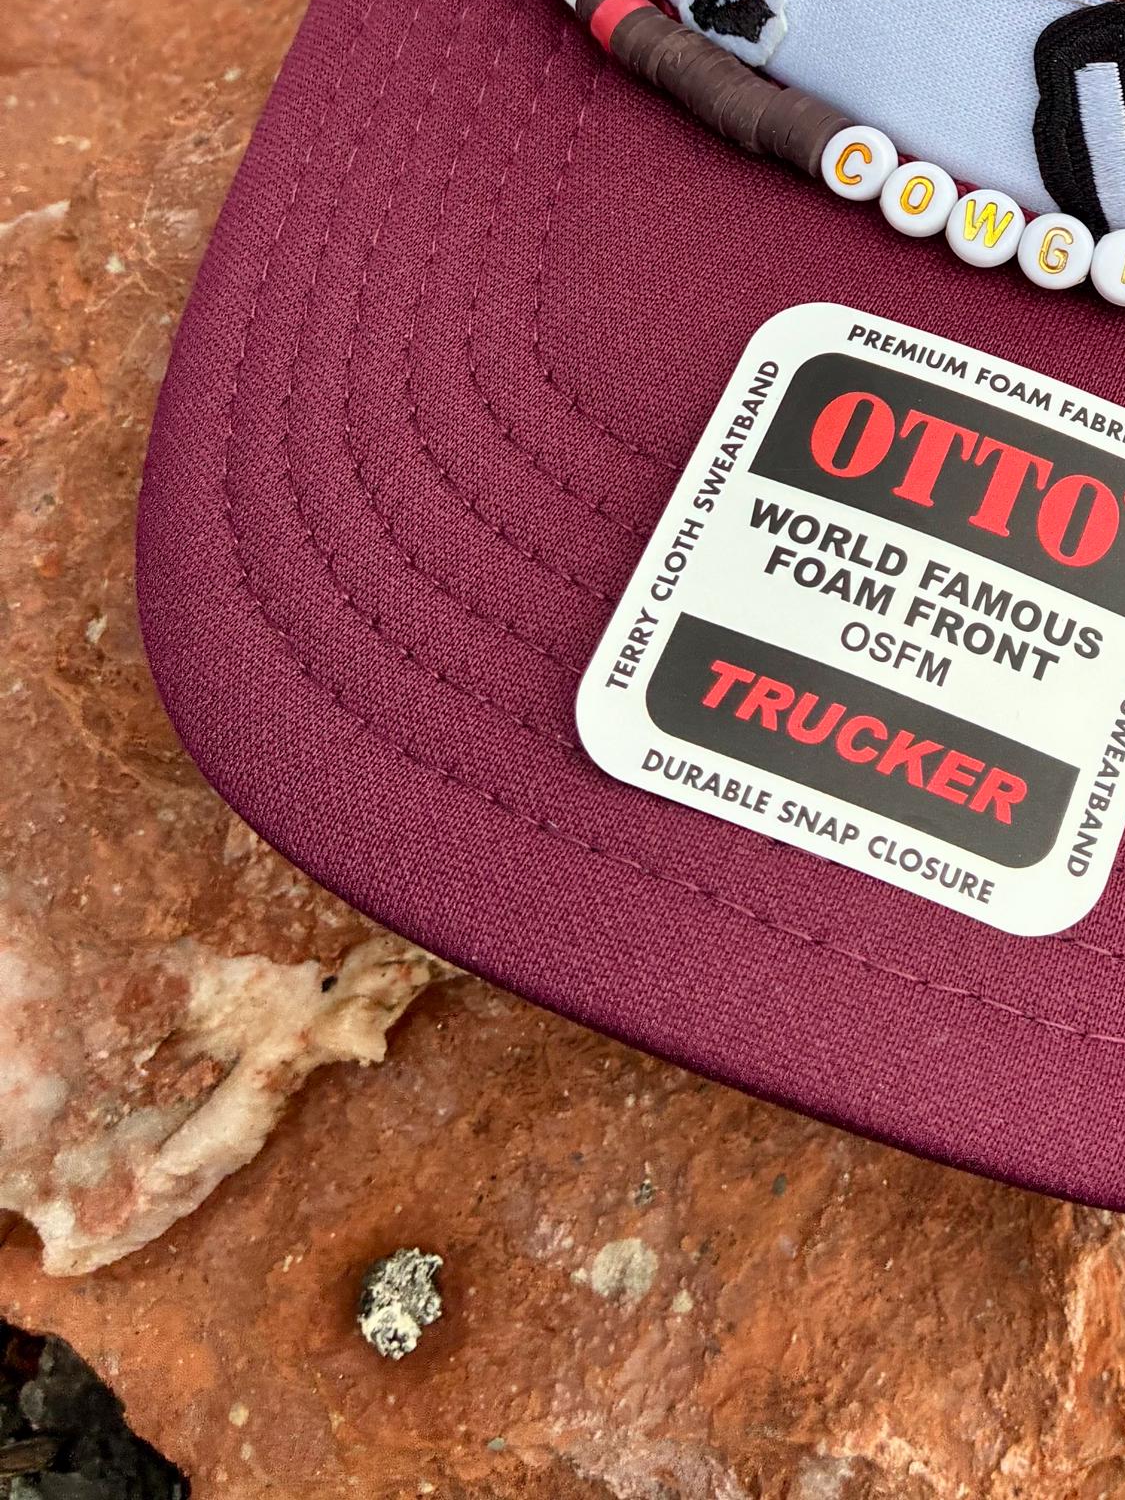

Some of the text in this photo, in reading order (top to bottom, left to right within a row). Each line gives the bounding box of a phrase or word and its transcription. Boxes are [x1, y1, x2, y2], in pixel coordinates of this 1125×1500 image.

[847, 324, 967, 378] PREMIUM
[974, 366, 1052, 411] FOAM
[605, 360, 780, 691] TERRY CLOTH SWEATBAND
[749, 497, 1104, 660] WORLD FAMOUS
[764, 546, 1058, 682] FOAM FRONT
[840, 622, 952, 688] OSFM
[701, 659, 1028, 825] TRUCKER
[641, 749, 995, 904] DURABLE SNAP CLOSURE
